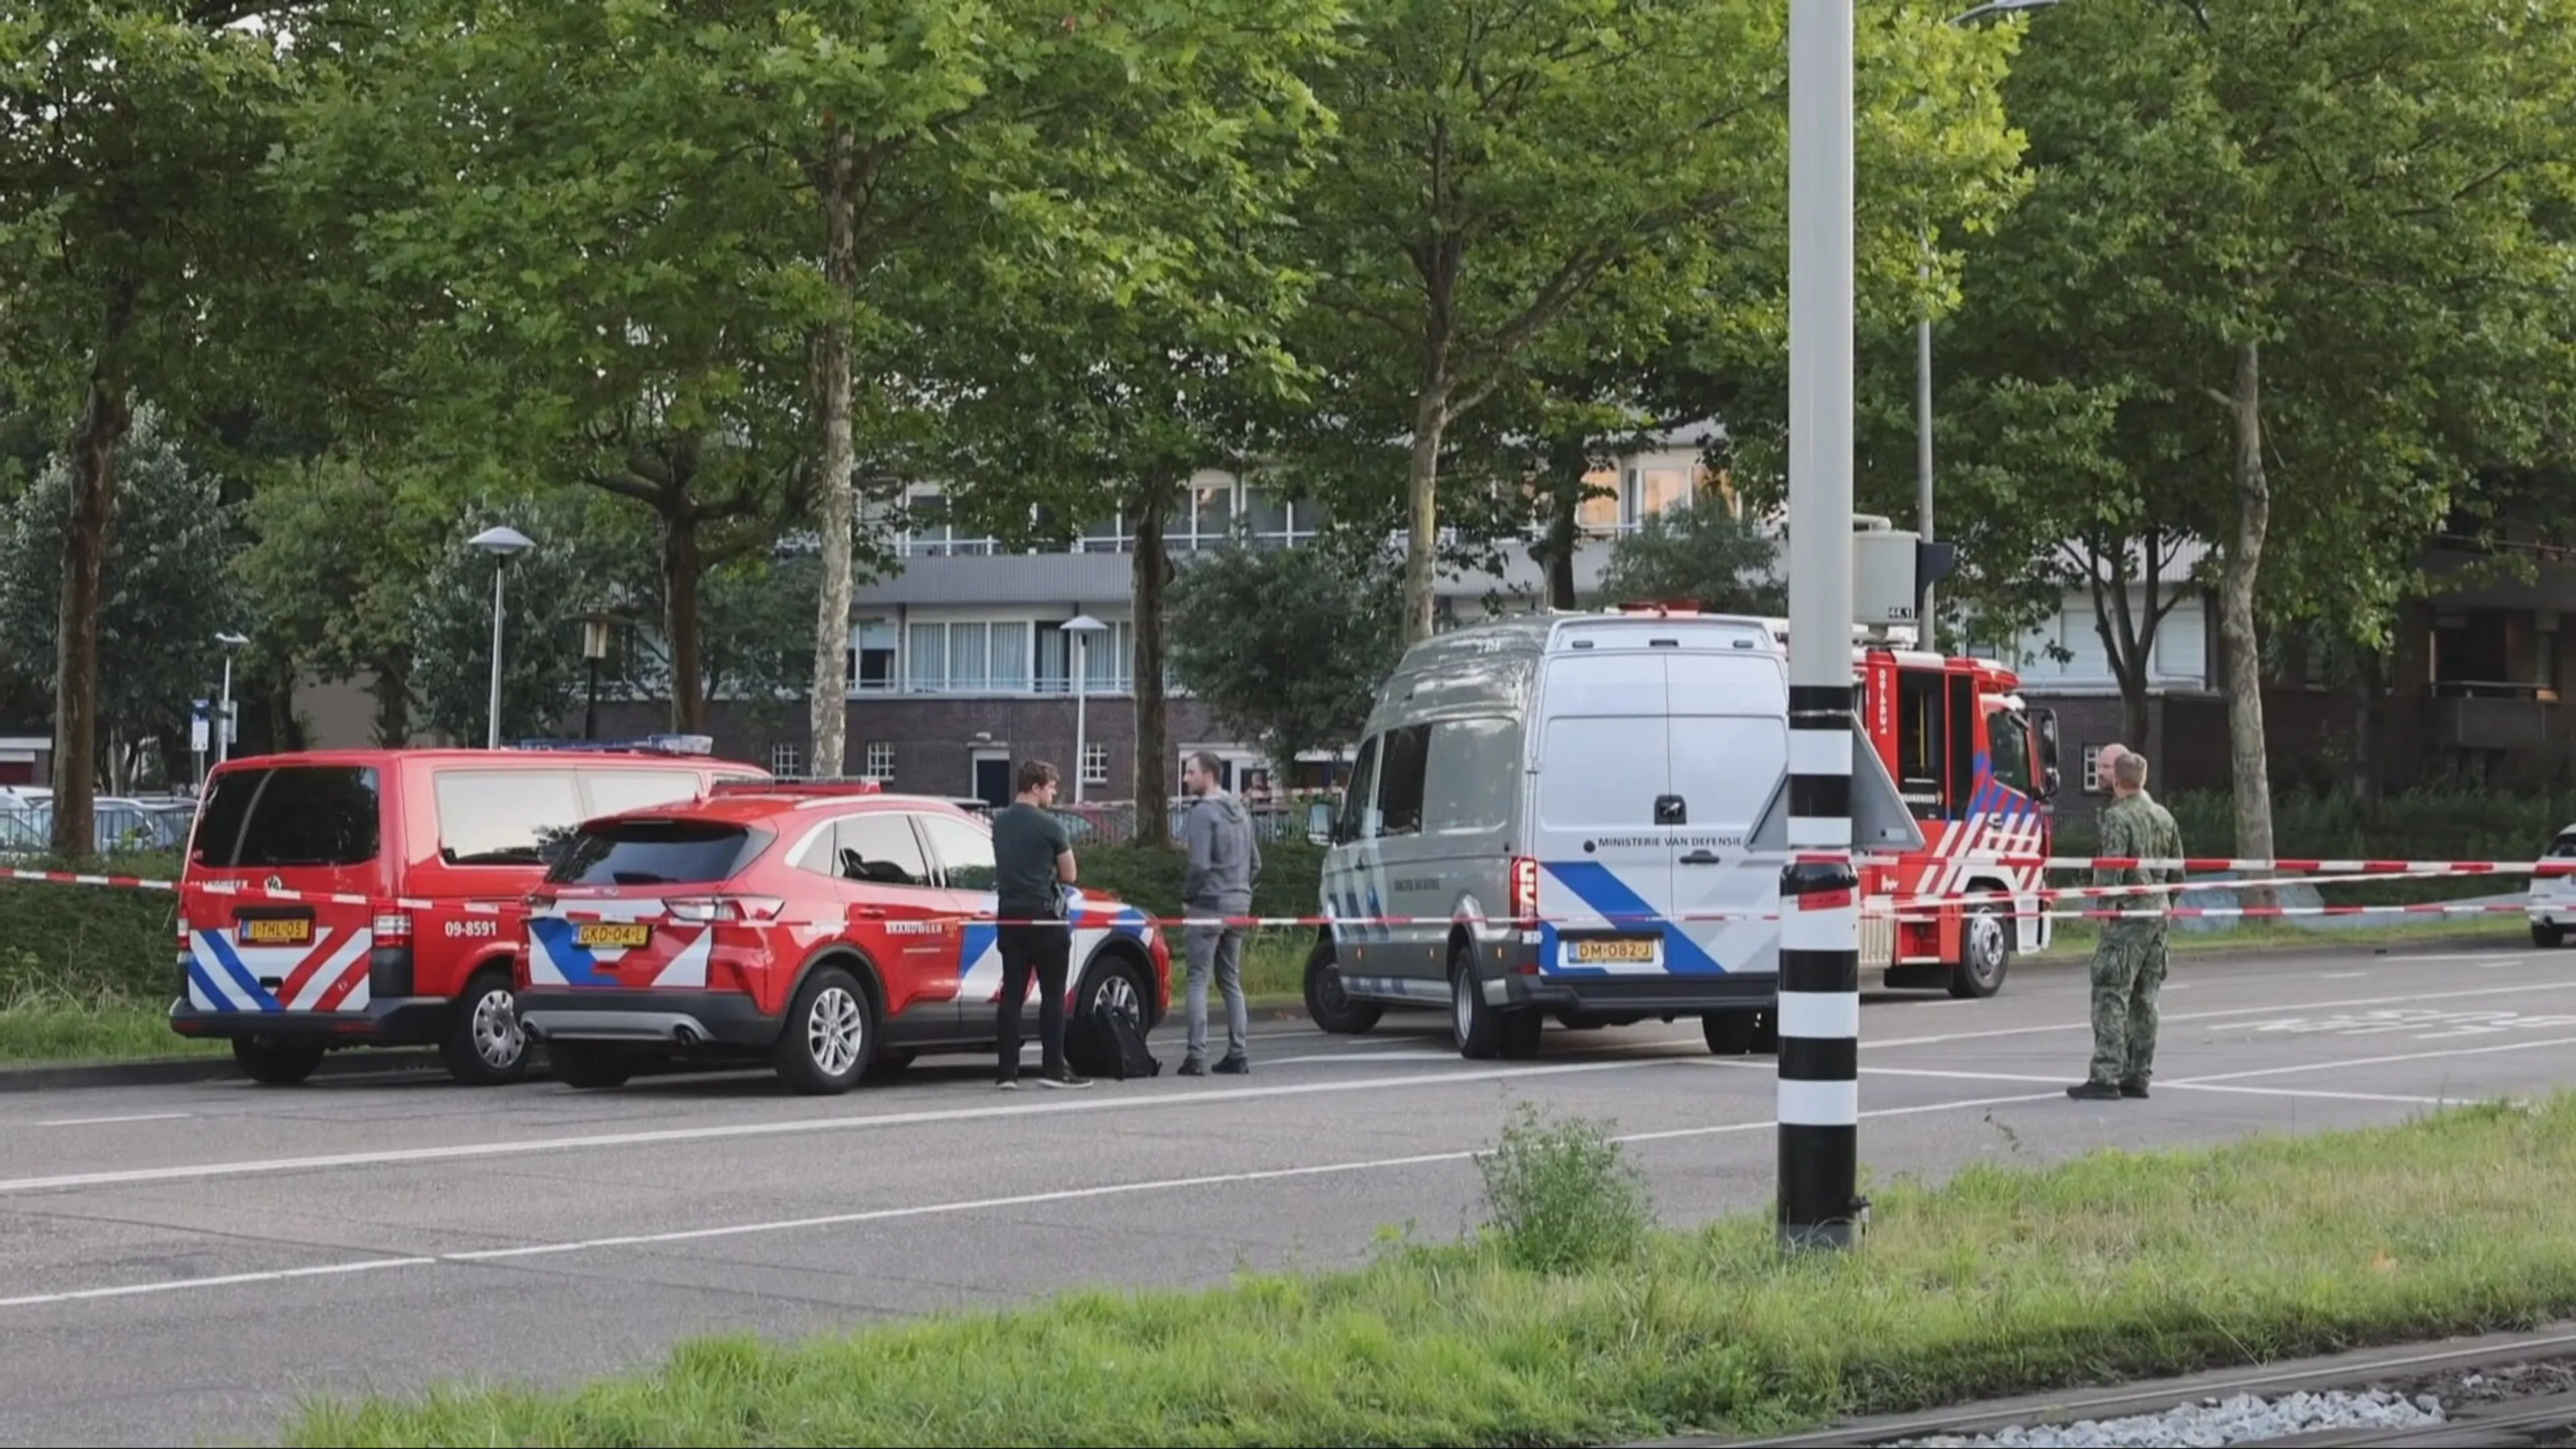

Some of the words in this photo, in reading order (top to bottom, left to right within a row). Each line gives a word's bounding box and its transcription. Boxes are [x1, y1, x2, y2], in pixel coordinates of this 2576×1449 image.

[1598, 837, 1660, 847] MINISTERIE
[1664, 837, 1688, 847] VAN
[1692, 837, 1741, 847] DEFENSIE
[445, 921, 496, 937] 09-8591
